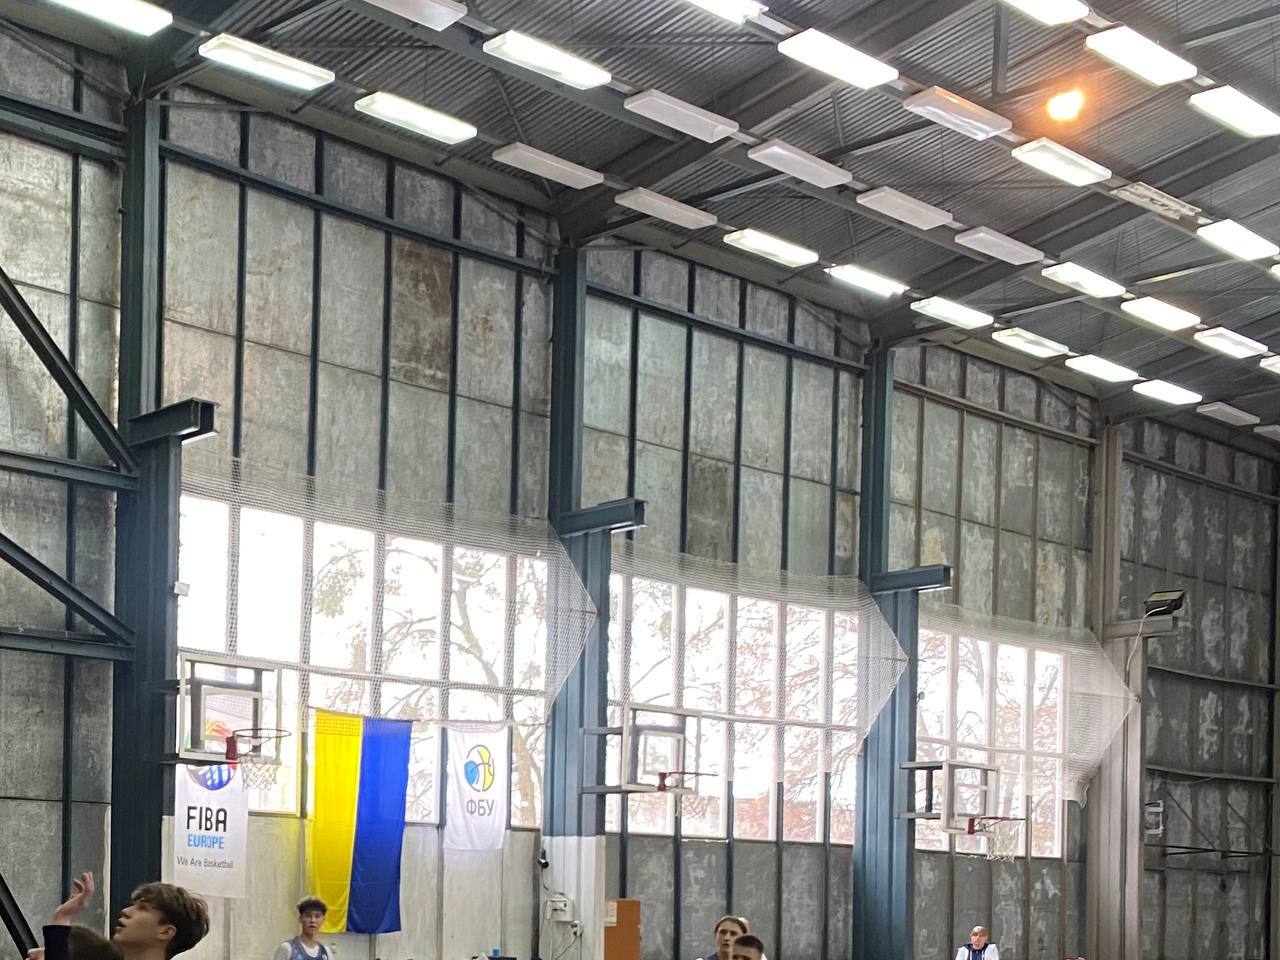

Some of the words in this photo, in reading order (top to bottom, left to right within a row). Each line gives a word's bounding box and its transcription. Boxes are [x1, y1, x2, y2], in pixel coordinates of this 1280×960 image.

[466, 798, 494, 817] ФБУ
[186, 805, 228, 832] FIBA
[187, 834, 225, 849] EUROPE
[177, 856, 188, 866] We
[190, 857, 202, 867] Are
